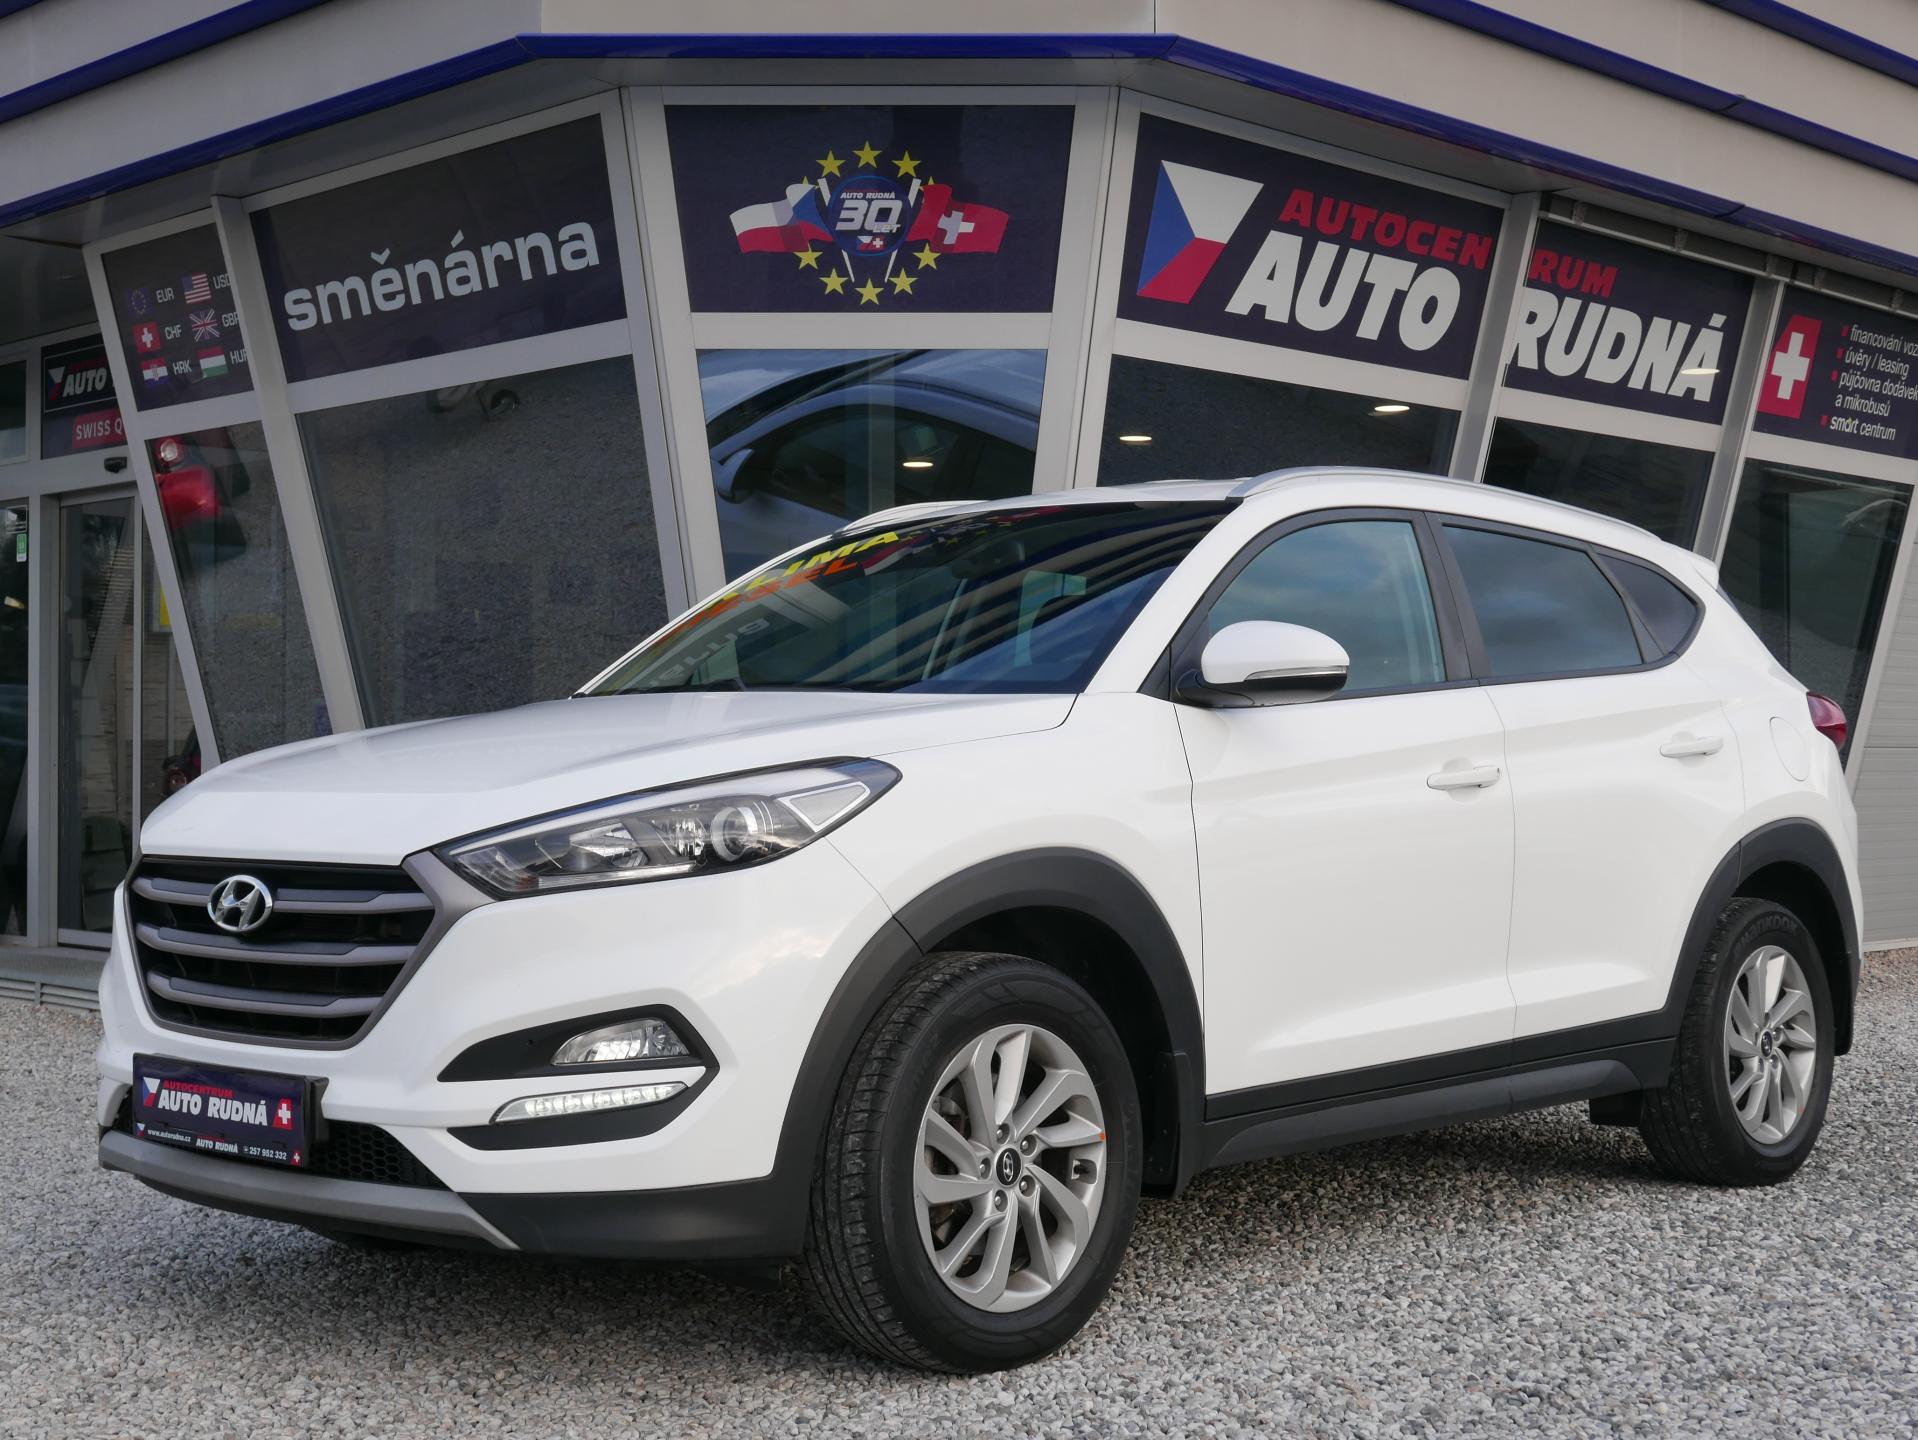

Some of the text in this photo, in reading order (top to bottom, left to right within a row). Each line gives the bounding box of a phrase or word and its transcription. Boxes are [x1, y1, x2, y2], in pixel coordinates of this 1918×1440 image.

[835, 199, 903, 231] 30
[283, 221, 600, 331] směnárna
[156, 287, 175, 303] EUR
[1224, 229, 1727, 402] AUTO RUDNÁ
[164, 324, 182, 340] CHF
[1850, 324, 1904, 352] financování
[172, 360, 192, 375] HRK
[1845, 346, 1872, 371] úvěry
[1877, 353, 1910, 380] leasing
[62, 367, 107, 398] AUTO
[1838, 369, 1881, 392] půjčovna
[1835, 393, 1891, 417] a mikrobusů
[76, 420, 111, 440] SWISS
[1860, 419, 1896, 441] centrum
[163, 1079, 234, 1098] AUTOCENTRUM
[157, 1089, 268, 1127] AUTO RUDNÁ
[195, 1138, 214, 1149] AUTO
[214, 1142, 239, 1154] RUDNÁ
[249, 1146, 261, 1156] 257
[261, 1149, 274, 1158] 952
